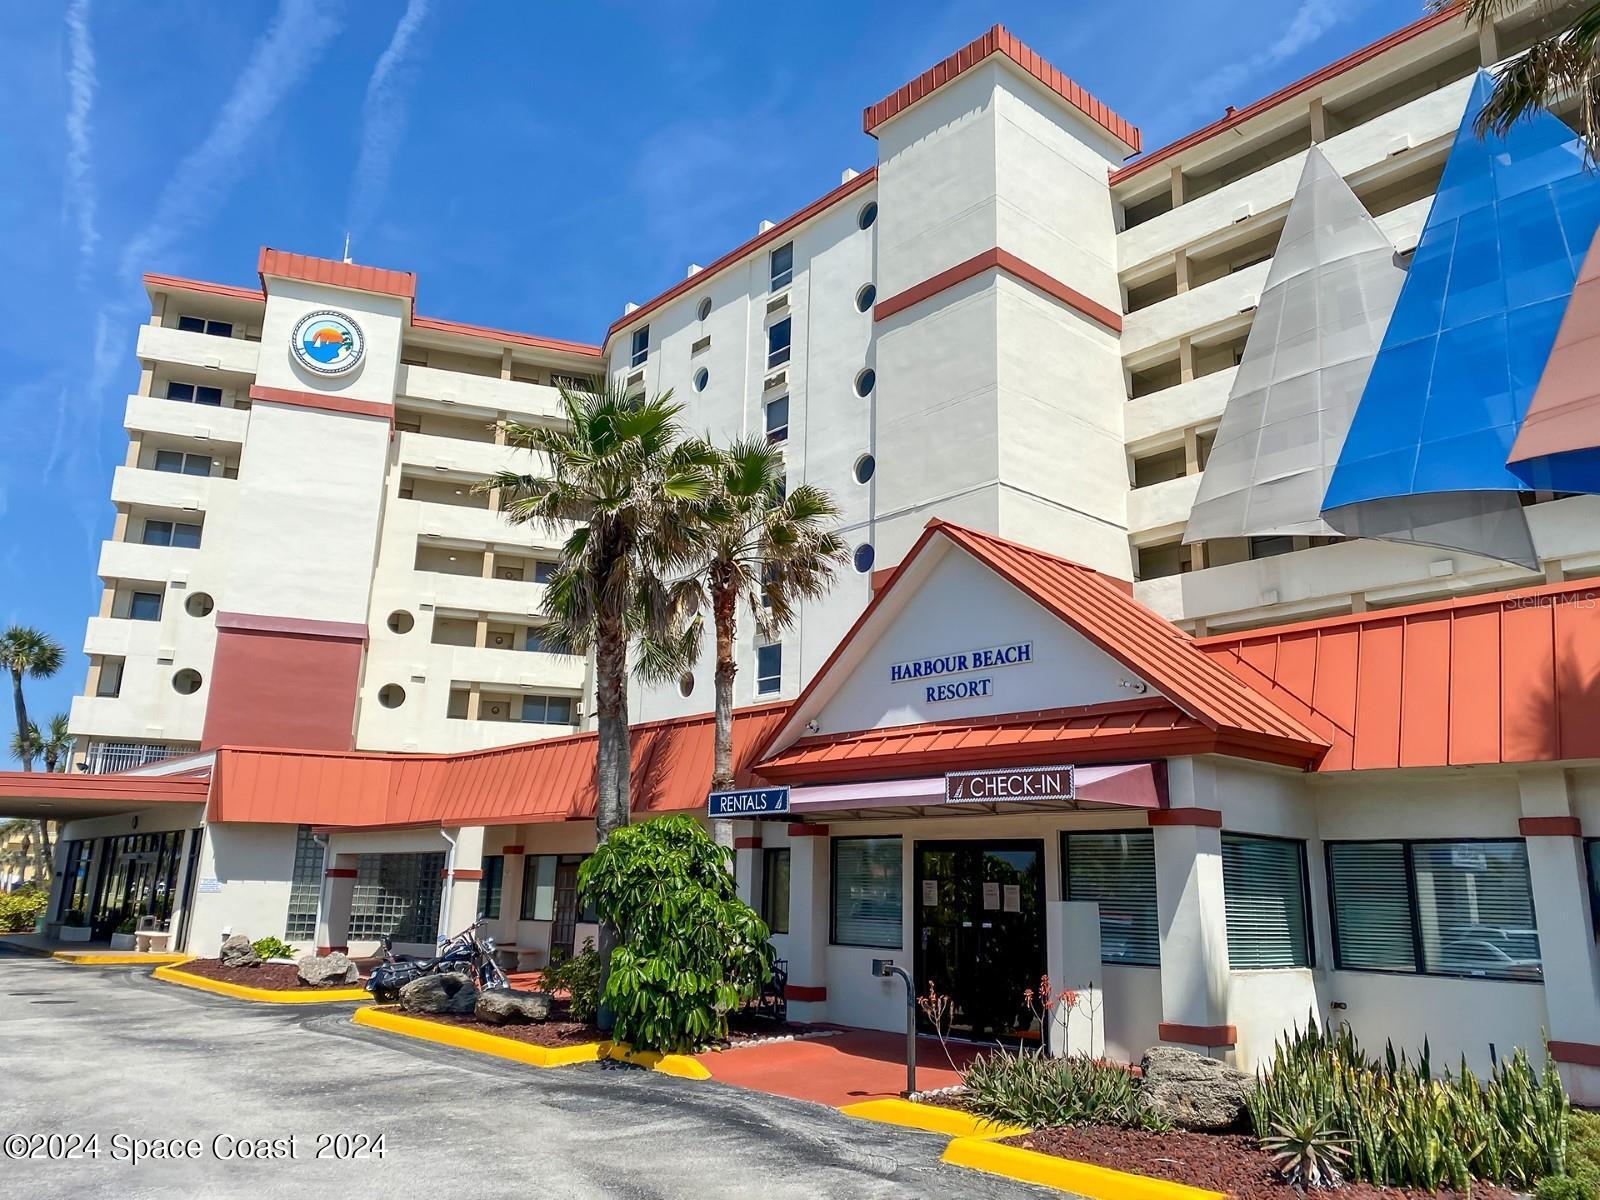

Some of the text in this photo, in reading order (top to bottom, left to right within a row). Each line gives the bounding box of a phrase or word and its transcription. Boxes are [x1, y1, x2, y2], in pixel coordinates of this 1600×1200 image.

[891, 644, 1031, 681] HARBOUR BEACH
[926, 679, 991, 702] RESORT
[969, 773, 1063, 798] CHECK-IN
[719, 793, 767, 812] RENTALS
